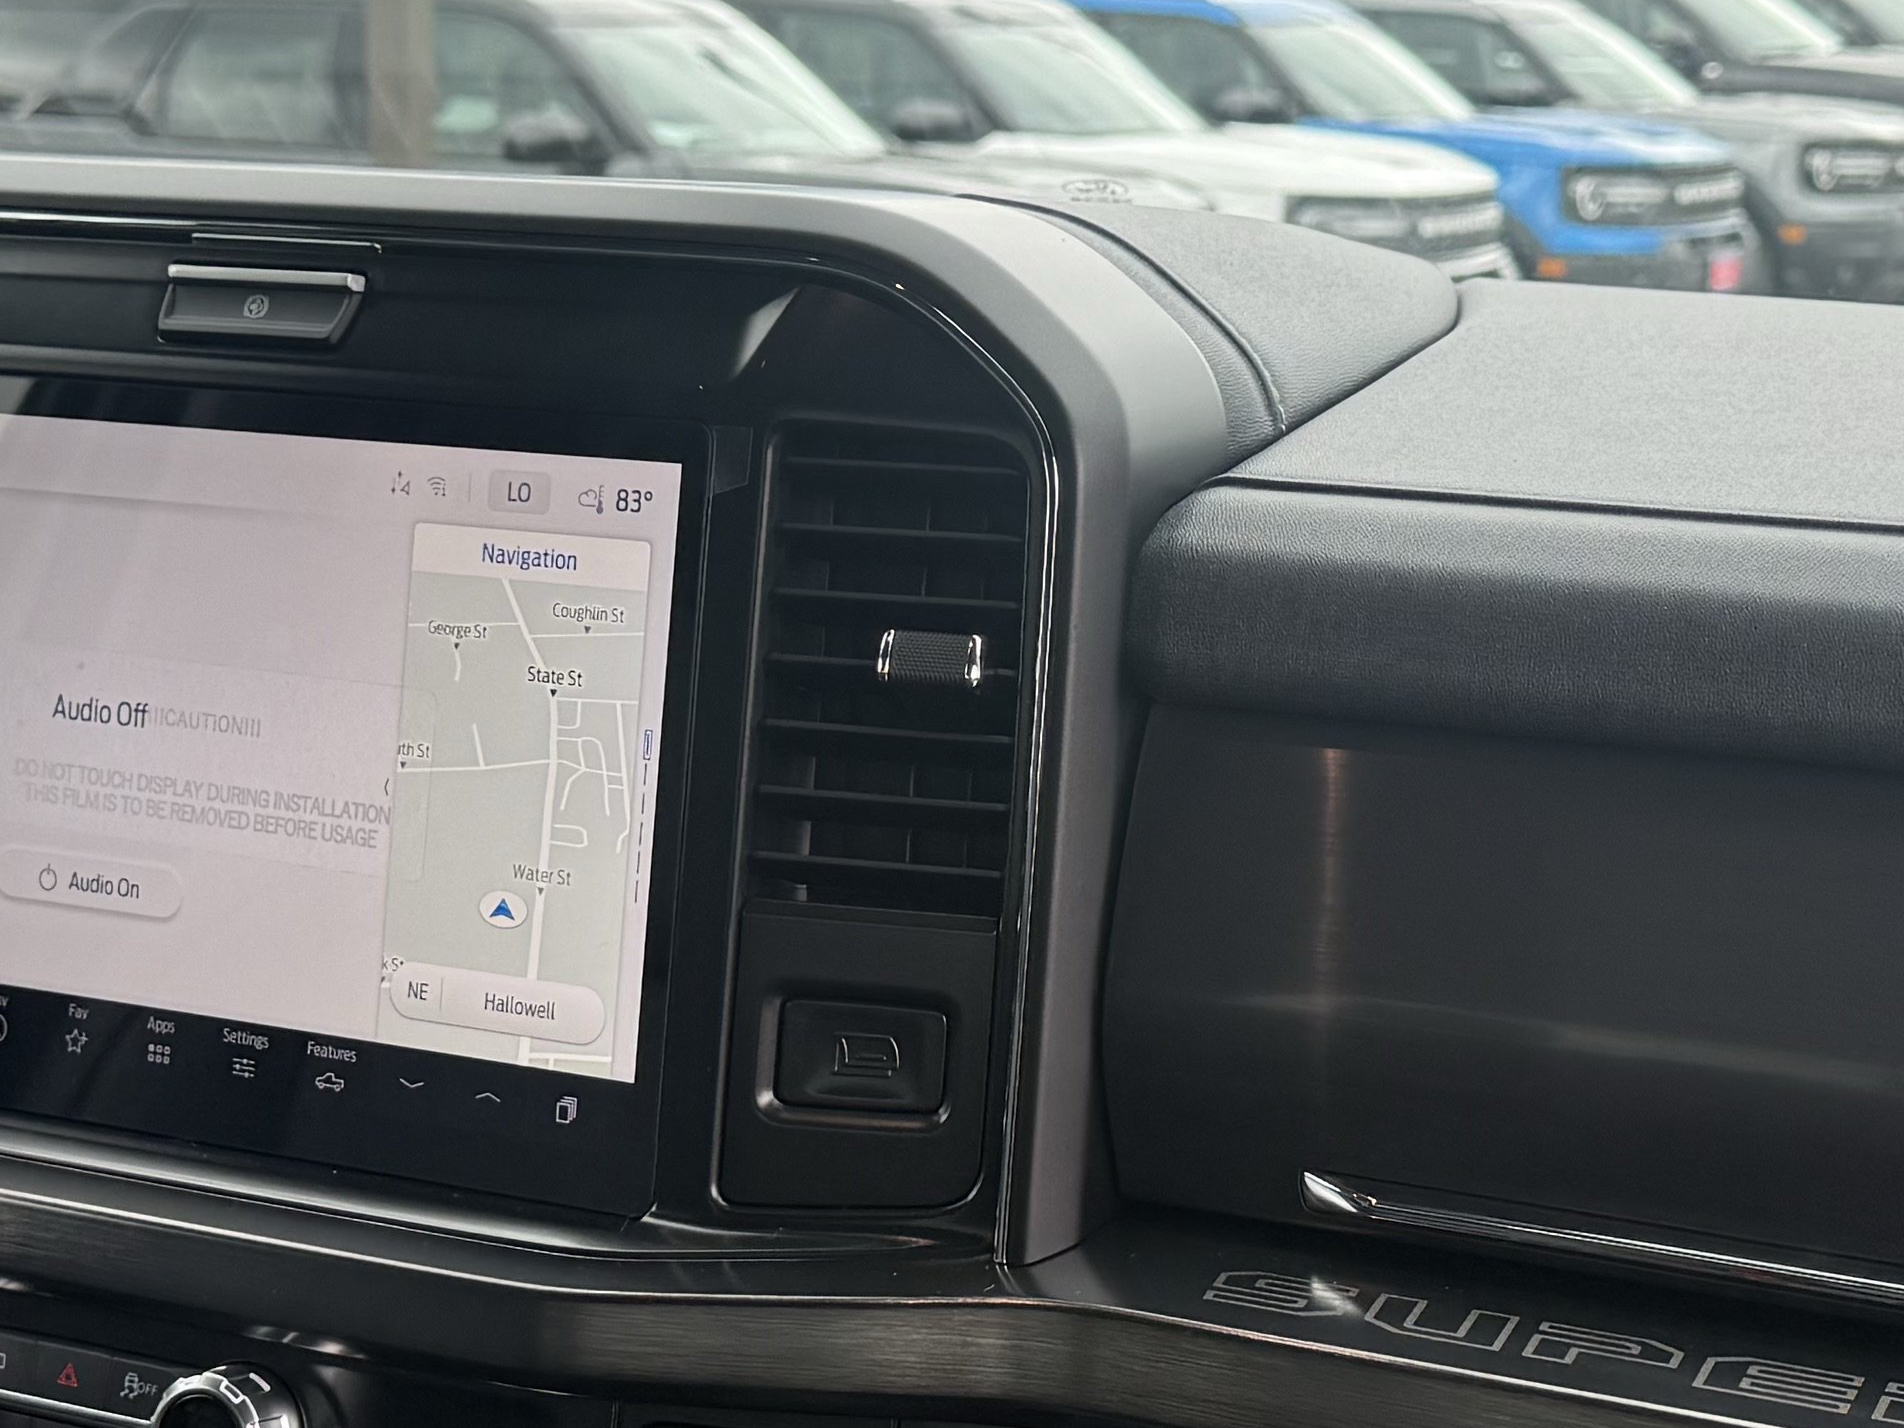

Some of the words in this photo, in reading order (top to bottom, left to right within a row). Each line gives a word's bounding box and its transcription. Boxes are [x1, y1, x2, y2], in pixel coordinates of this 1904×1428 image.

[507, 480, 532, 504] LO
[615, 487, 654, 515] 83°
[481, 541, 578, 571] Navigation
[551, 601, 609, 625] Coughlin
[610, 608, 626, 625] St
[426, 618, 471, 640] George
[472, 623, 488, 641] St
[527, 665, 565, 687] State
[567, 669, 584, 689] St
[51, 692, 112, 724] Audio
[116, 700, 150, 729] Off
[416, 742, 431, 759] St
[76, 765, 134, 793] TOUCH
[136, 772, 203, 800] DISPLAY
[207, 782, 270, 809] DURING
[273, 791, 392, 826] INSTALLATION
[119, 794, 143, 816] TO
[145, 798, 169, 820] BE
[170, 802, 251, 831] REMOVED
[252, 812, 319, 841] BEFORE
[320, 821, 380, 850] USAGE
[68, 871, 114, 896] Audio
[116, 876, 141, 900] On
[512, 863, 554, 885] Water
[556, 869, 572, 887] St
[67, 1002, 90, 1021] Fav
[407, 980, 430, 1001] NE
[484, 992, 556, 1021] Hallowell
[146, 1016, 177, 1036] Apps
[222, 1027, 270, 1051] Settings
[306, 1040, 358, 1064] Features
[137, 1382, 158, 1397] OFF
